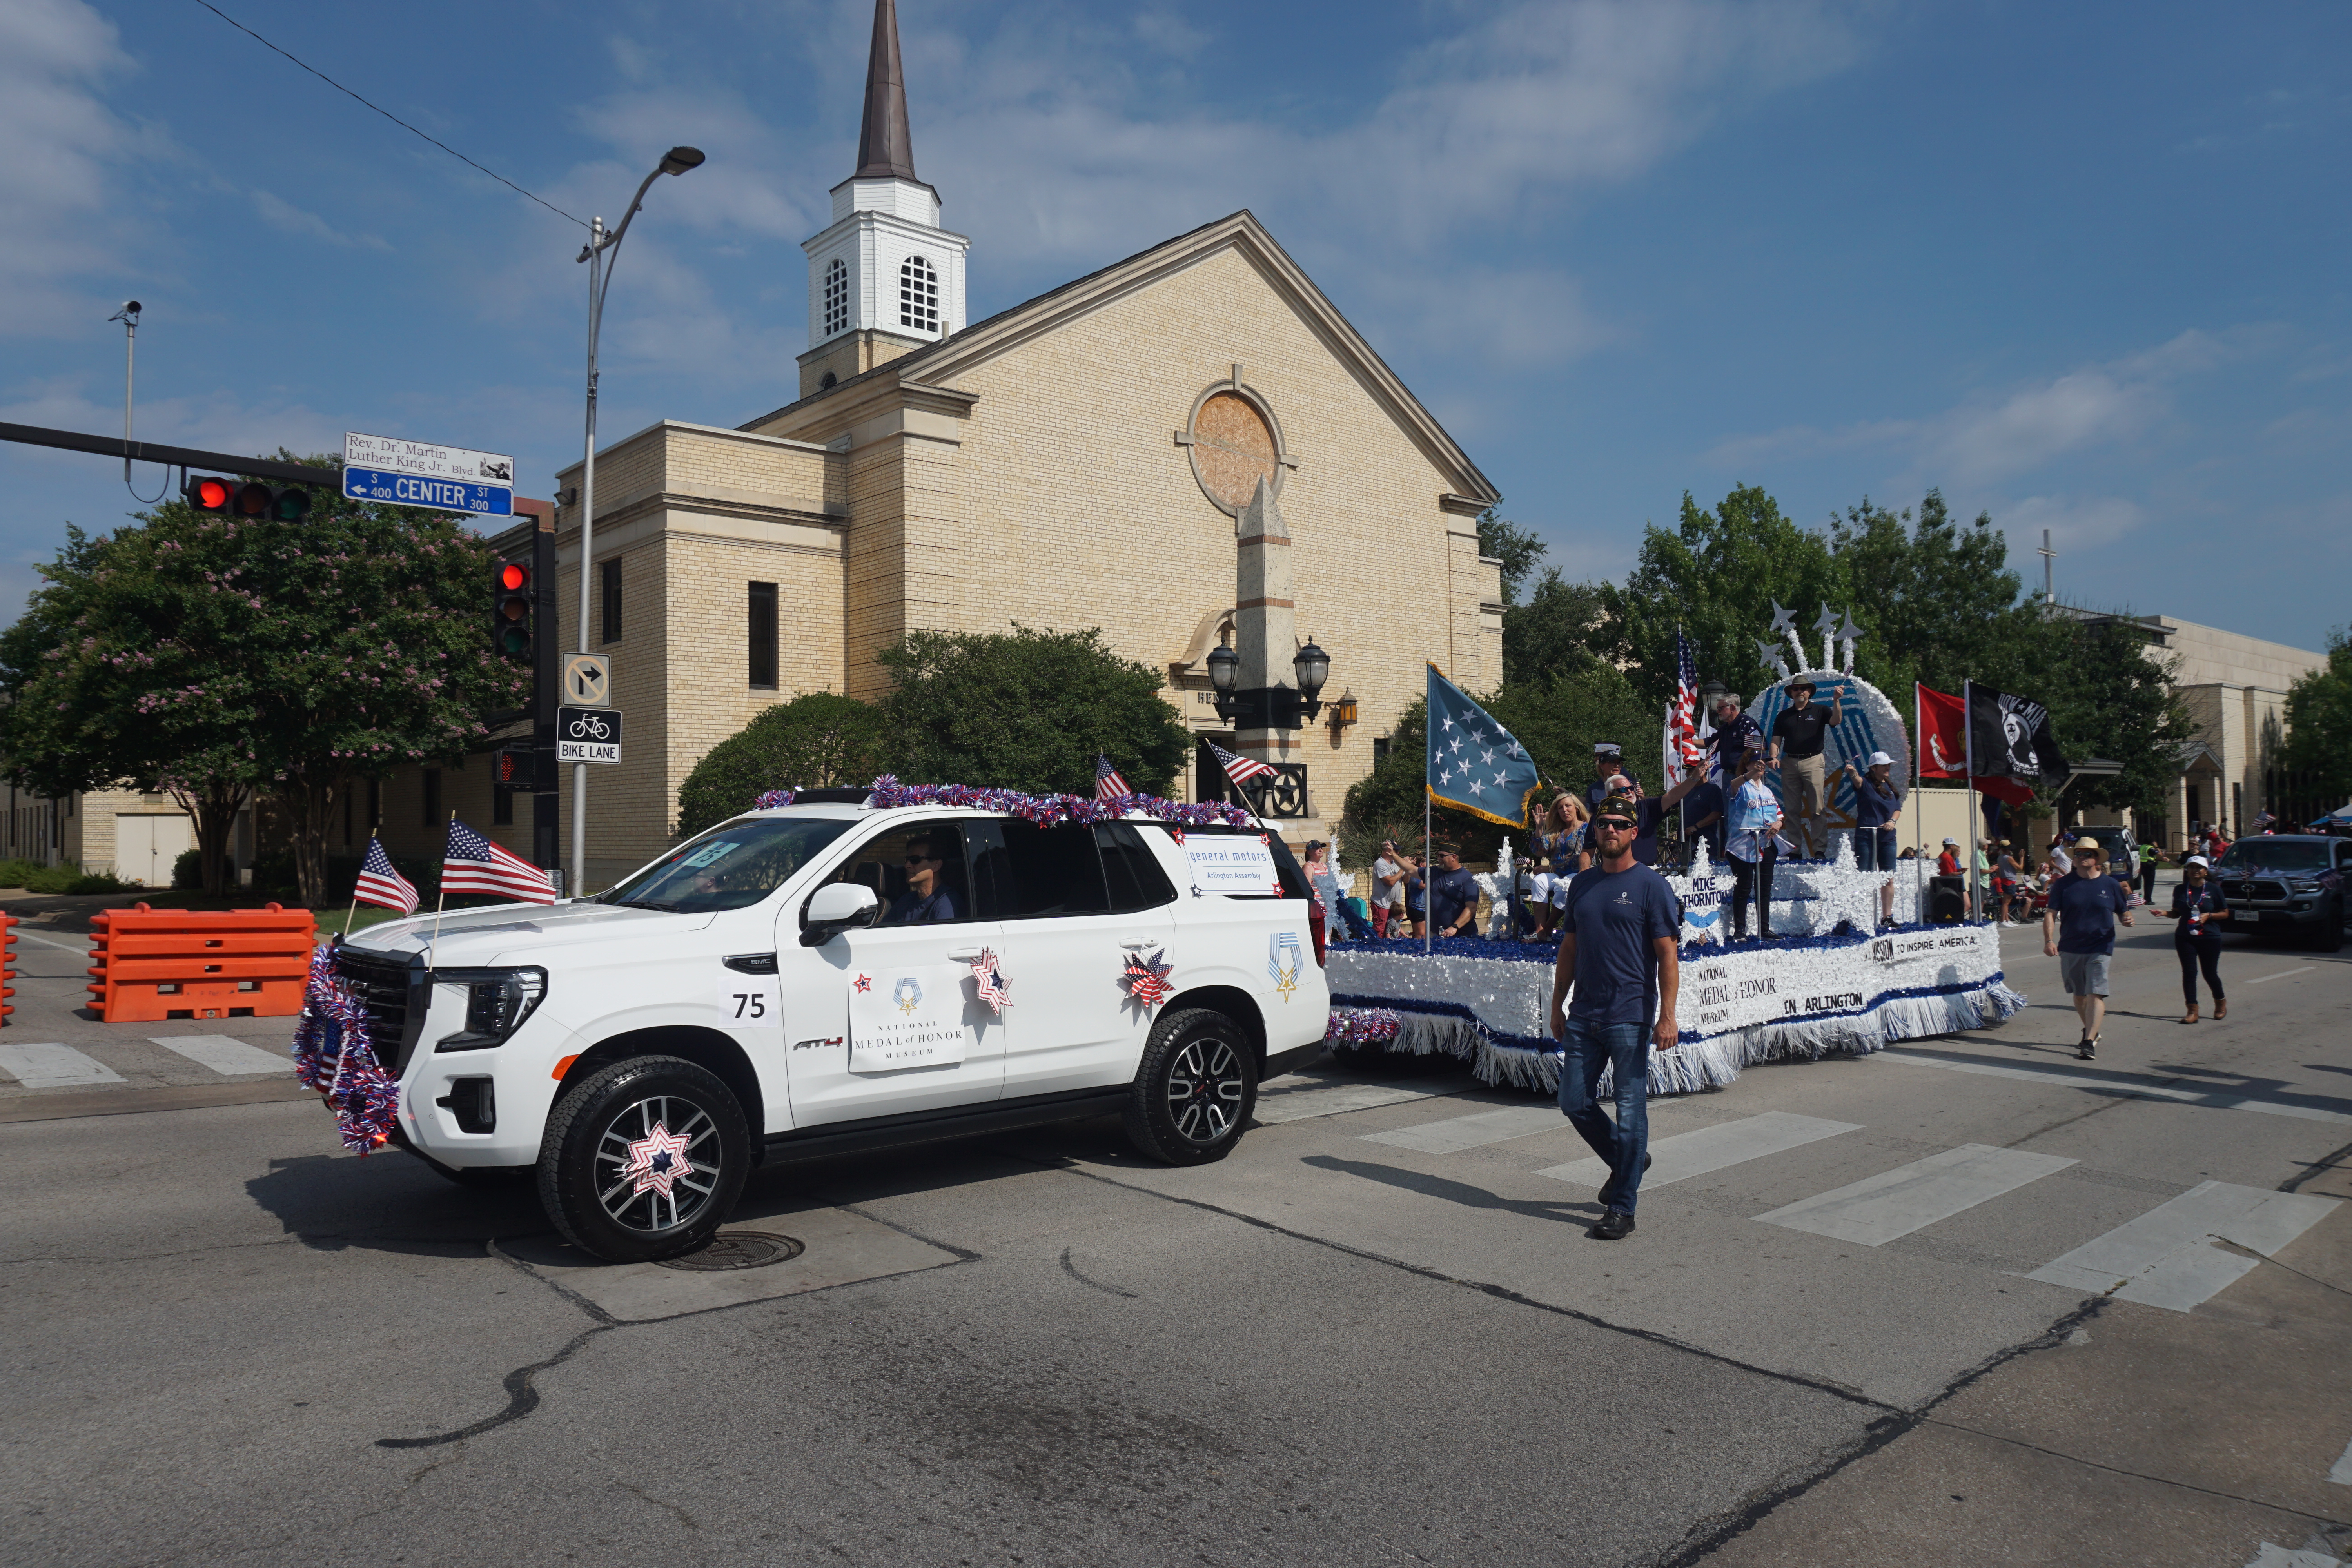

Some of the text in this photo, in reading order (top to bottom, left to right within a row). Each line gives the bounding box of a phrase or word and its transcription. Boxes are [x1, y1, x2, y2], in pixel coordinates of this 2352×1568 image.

[349, 436, 447, 459] Rev. Dr. Martin
[349, 449, 476, 476] Luther King Jr. Blvd.
[371, 473, 489, 498] S ST
[371, 478, 489, 511] 400 CENTER 300
[2021, 702, 2047, 737] MIA
[562, 744, 615, 759] BIKE LANE
[1935, 755, 1954, 770] UNITED
[693, 850, 721, 862] 75
[1190, 850, 1267, 862] general motors
[1693, 877, 1715, 892] MIKE
[1682, 890, 1728, 908] THORNTON
[1907, 940, 1933, 953] INSPIRE
[1699, 967, 1727, 982] NATIONAL
[1700, 985, 1731, 1007] MEDAL
[1740, 977, 1776, 999] HONOR
[733, 993, 765, 1018] 75
[1784, 992, 1862, 1014] IN ARLINGTON
[1700, 1009, 1729, 1024] MUSEUM
[878, 1021, 937, 1032] NATIONAL
[855, 1030, 962, 1049] MEDAL of HONOR
[886, 1049, 933, 1059] MUSEUM
